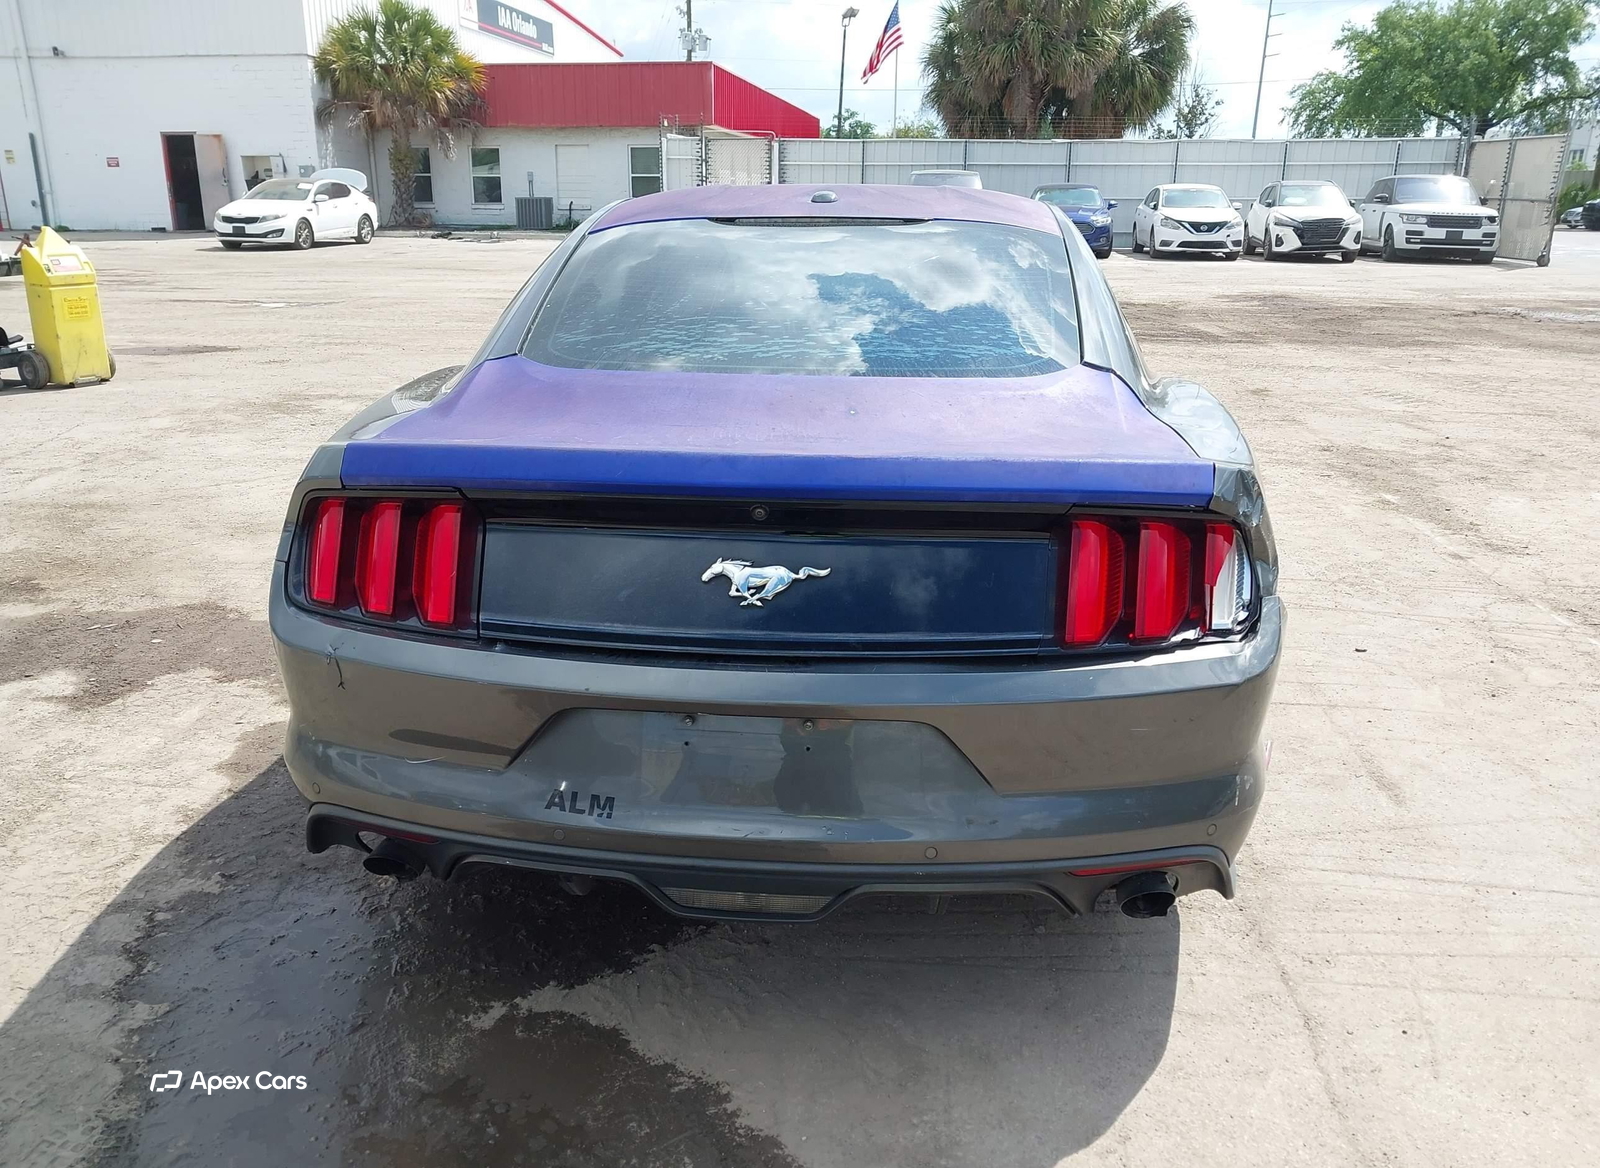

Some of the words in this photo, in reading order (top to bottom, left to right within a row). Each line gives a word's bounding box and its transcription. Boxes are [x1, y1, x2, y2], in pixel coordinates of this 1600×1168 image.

[497, 5, 512, 30] IAA
[511, 11, 538, 39] Orlando
[544, 788, 616, 819] ALM
